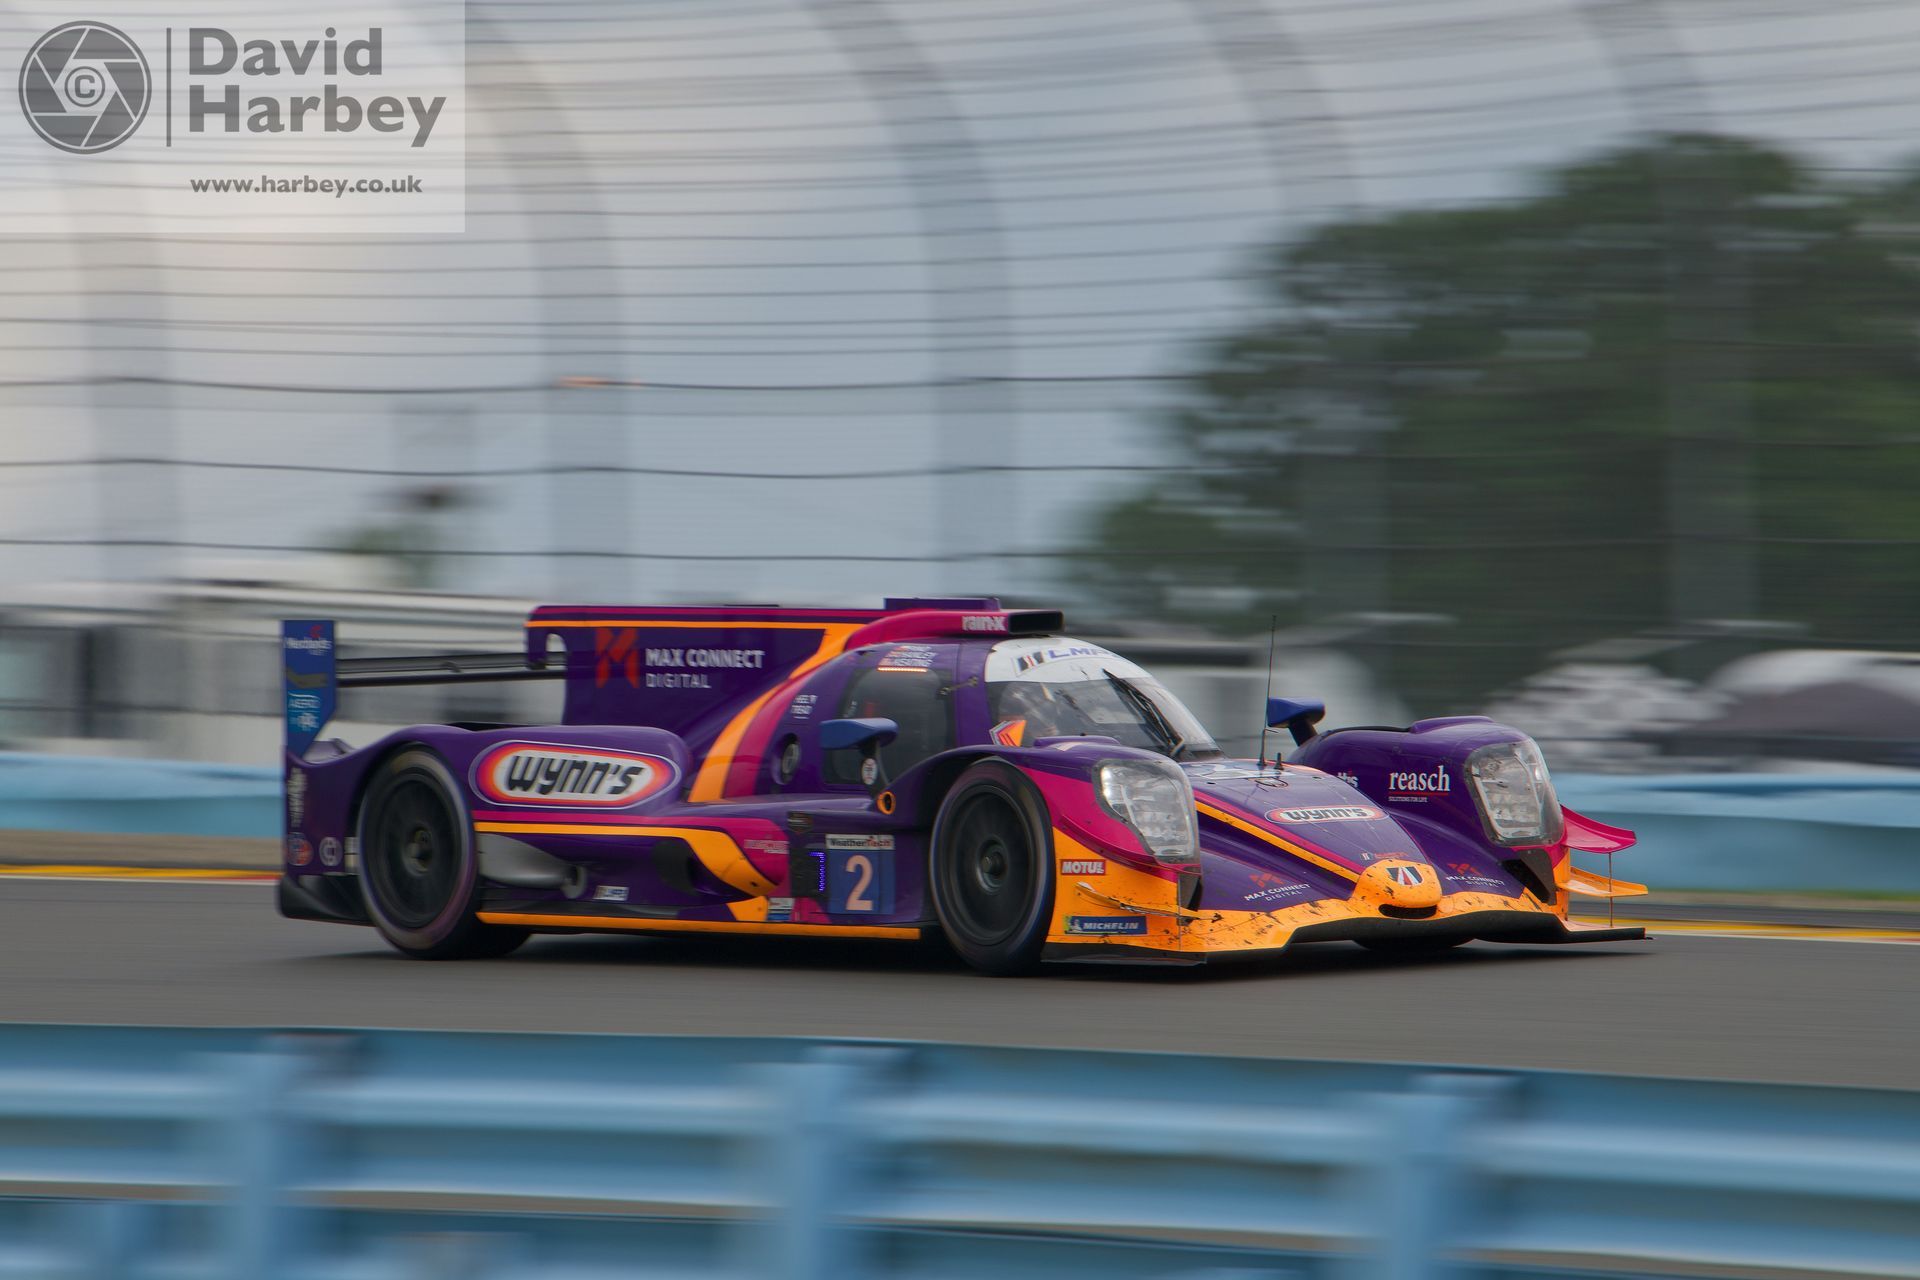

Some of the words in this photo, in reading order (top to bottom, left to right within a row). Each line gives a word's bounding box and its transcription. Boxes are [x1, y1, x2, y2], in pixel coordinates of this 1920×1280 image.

[645, 648, 684, 667] MAX
[686, 650, 765, 668] CONNECT
[646, 673, 711, 688] DIGITAL
[1389, 765, 1450, 791] reasch
[1062, 861, 1104, 874] MOTUL
[845, 855, 873, 911] 2
[1244, 890, 1267, 901] MAX
[1268, 883, 1311, 894] CONNECT
[1265, 890, 1302, 901] DIGITAL
